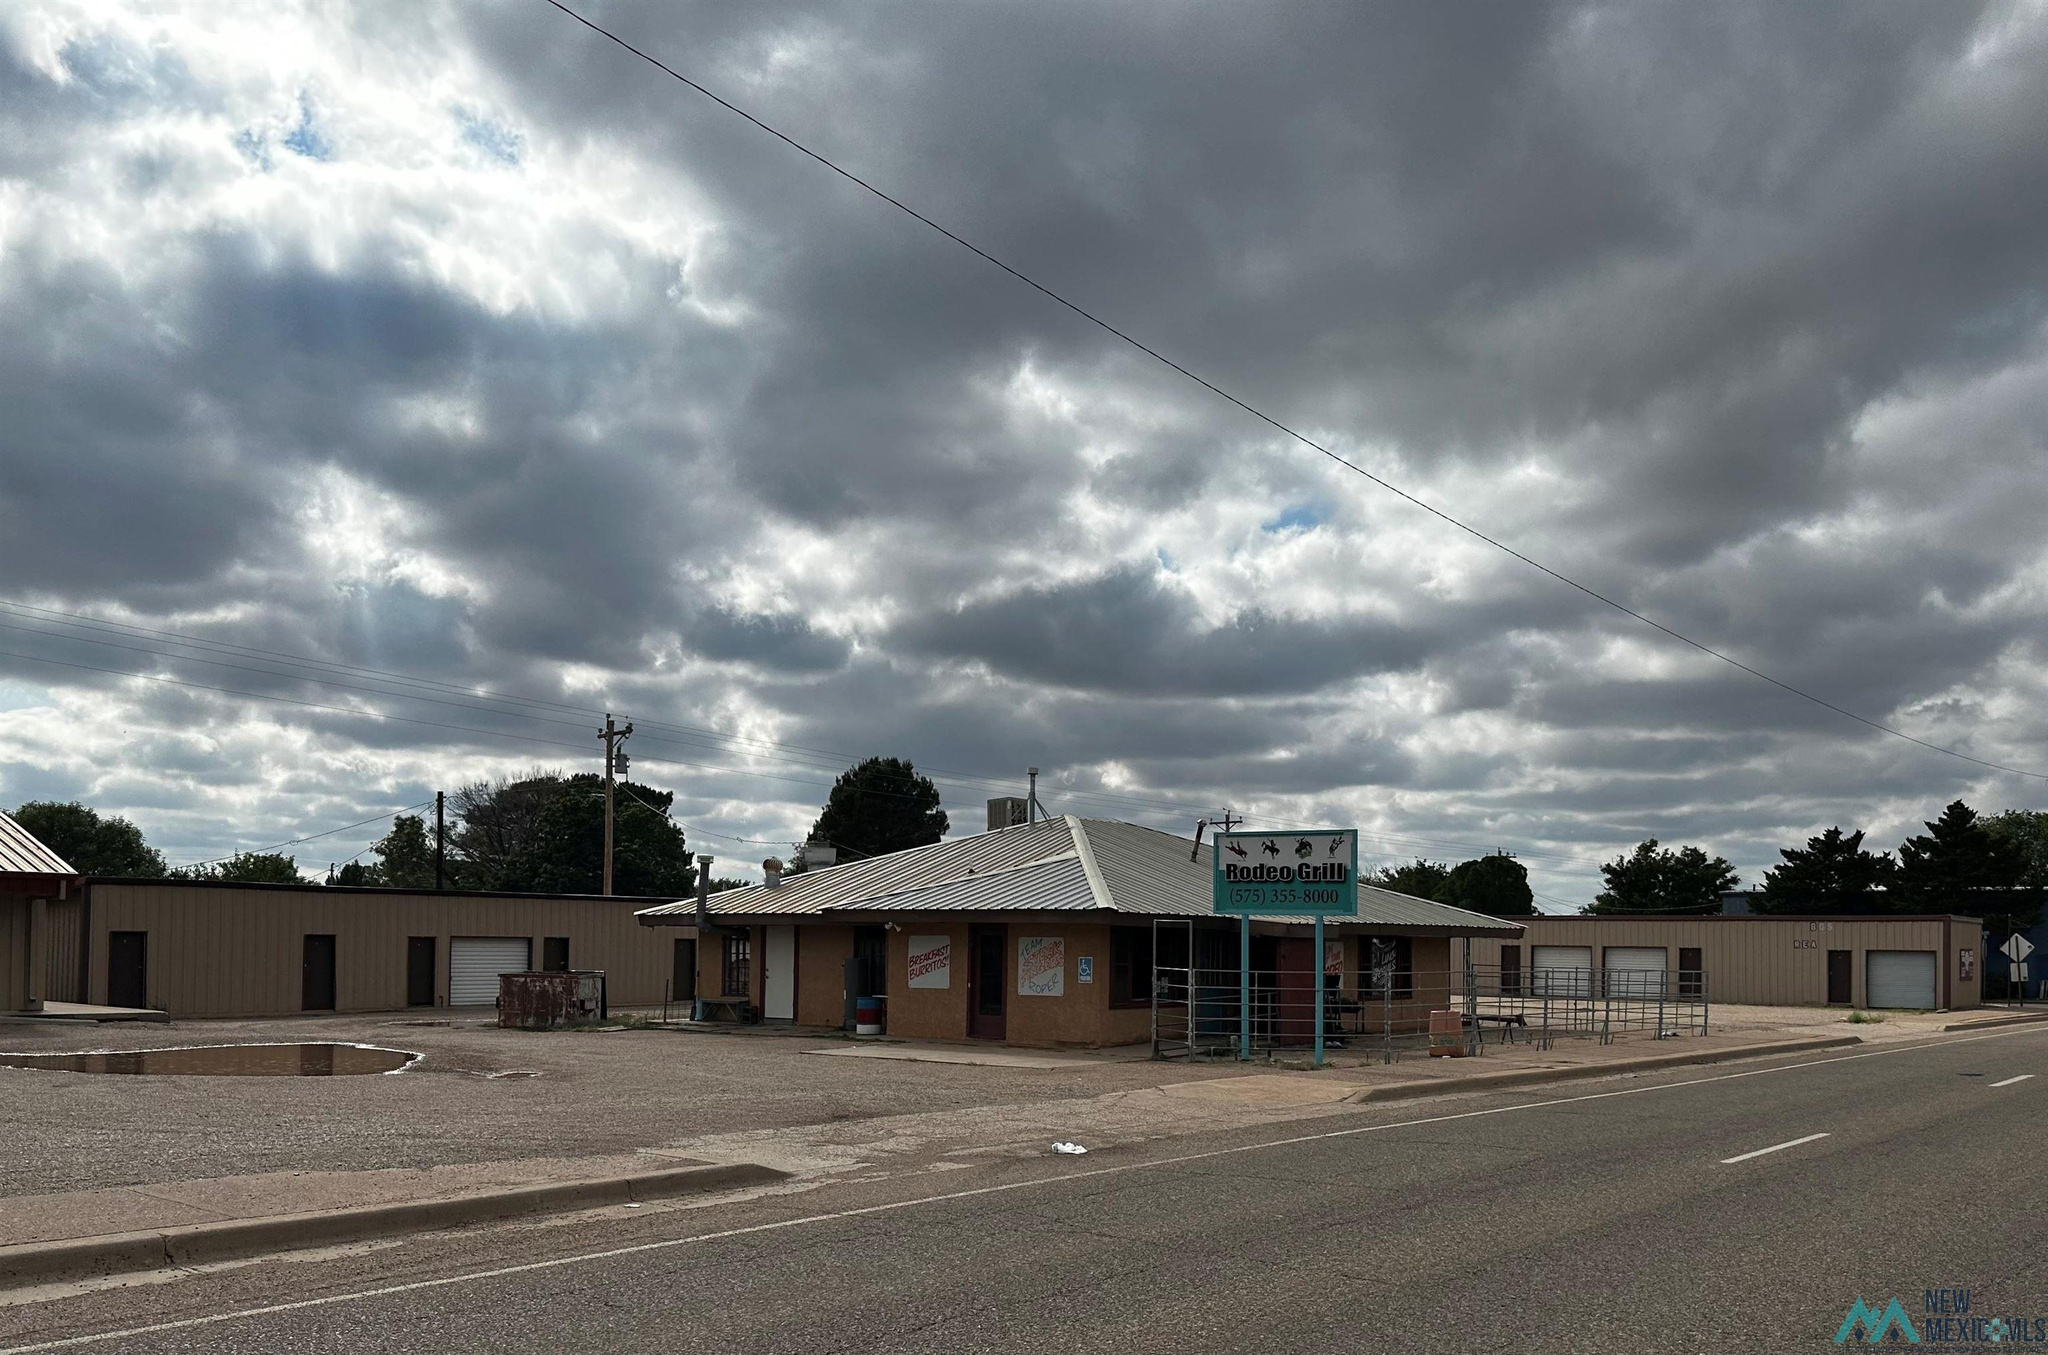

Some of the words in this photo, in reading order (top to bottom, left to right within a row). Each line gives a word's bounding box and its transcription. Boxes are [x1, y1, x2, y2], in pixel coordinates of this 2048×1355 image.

[1225, 863, 1293, 882] Rodeo
[1297, 863, 1346, 882] Grill
[1230, 888, 1266, 906] (575)
[1271, 889, 1339, 904] 355-8000
[1020, 938, 1043, 959] TEAM
[1793, 940, 1817, 949] REA
[909, 944, 950, 968] BREAKFAST
[1028, 973, 1059, 994] ROPER
